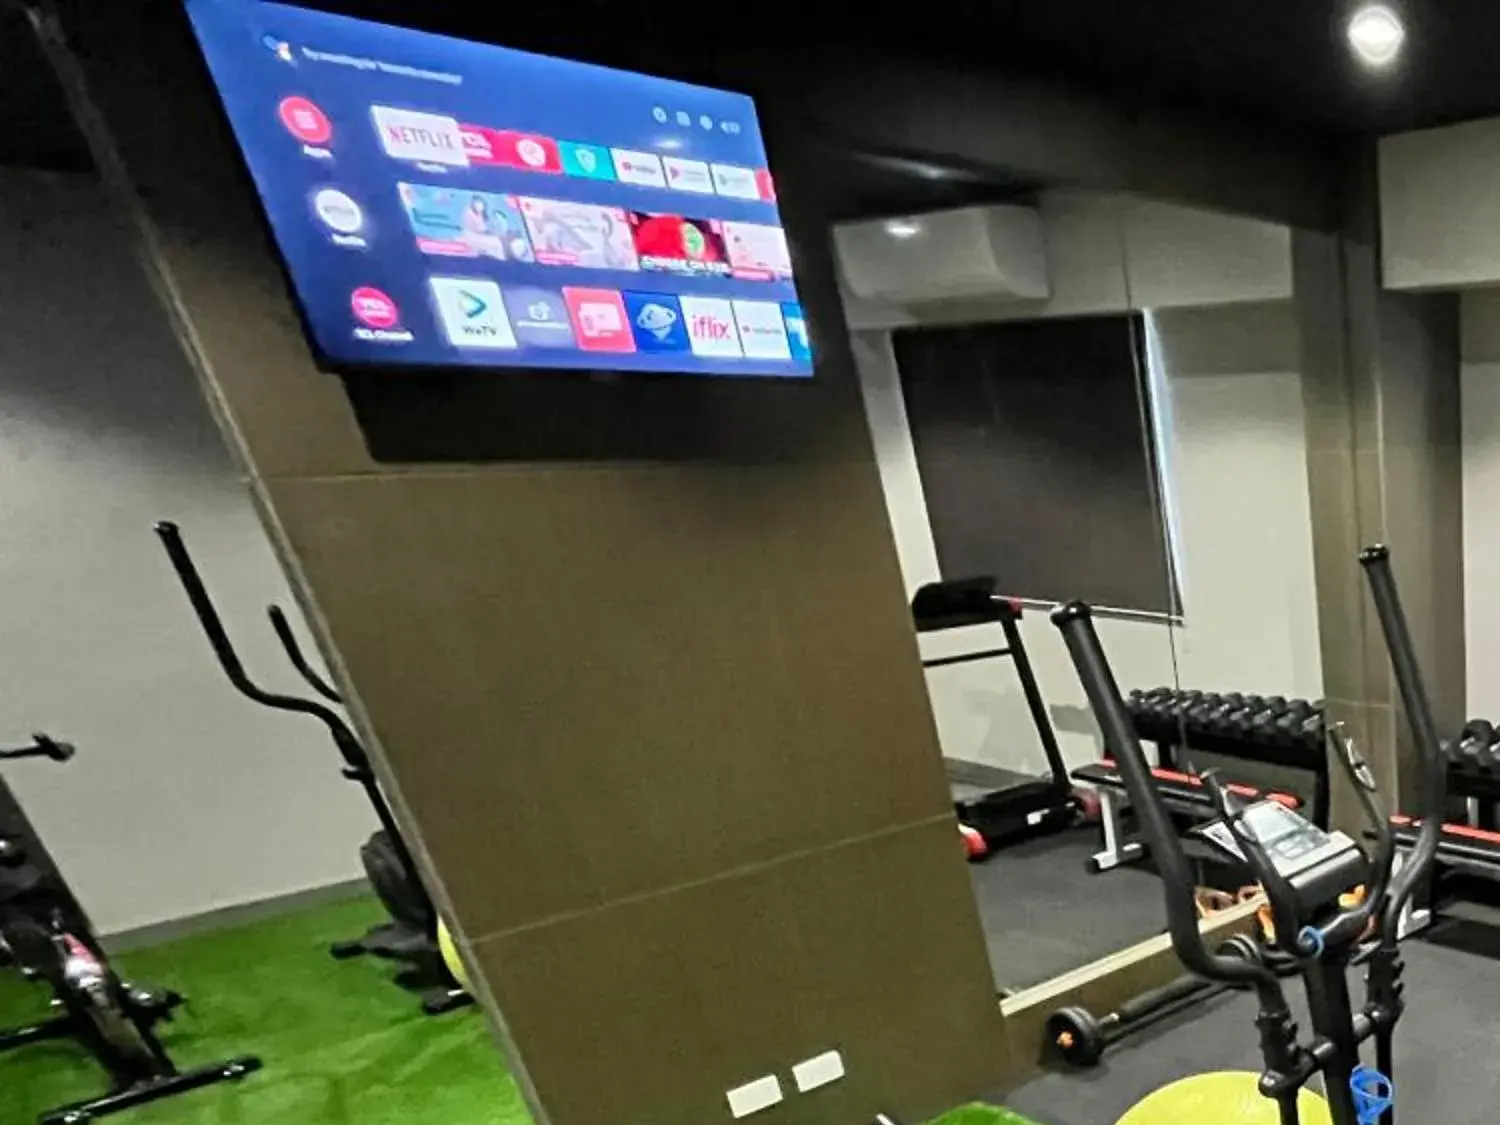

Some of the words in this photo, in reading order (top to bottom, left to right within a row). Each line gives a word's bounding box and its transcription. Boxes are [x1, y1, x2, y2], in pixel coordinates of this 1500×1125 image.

[388, 124, 455, 150] NETFLIX
[461, 324, 498, 337] WeTV
[691, 314, 731, 340] iflix
